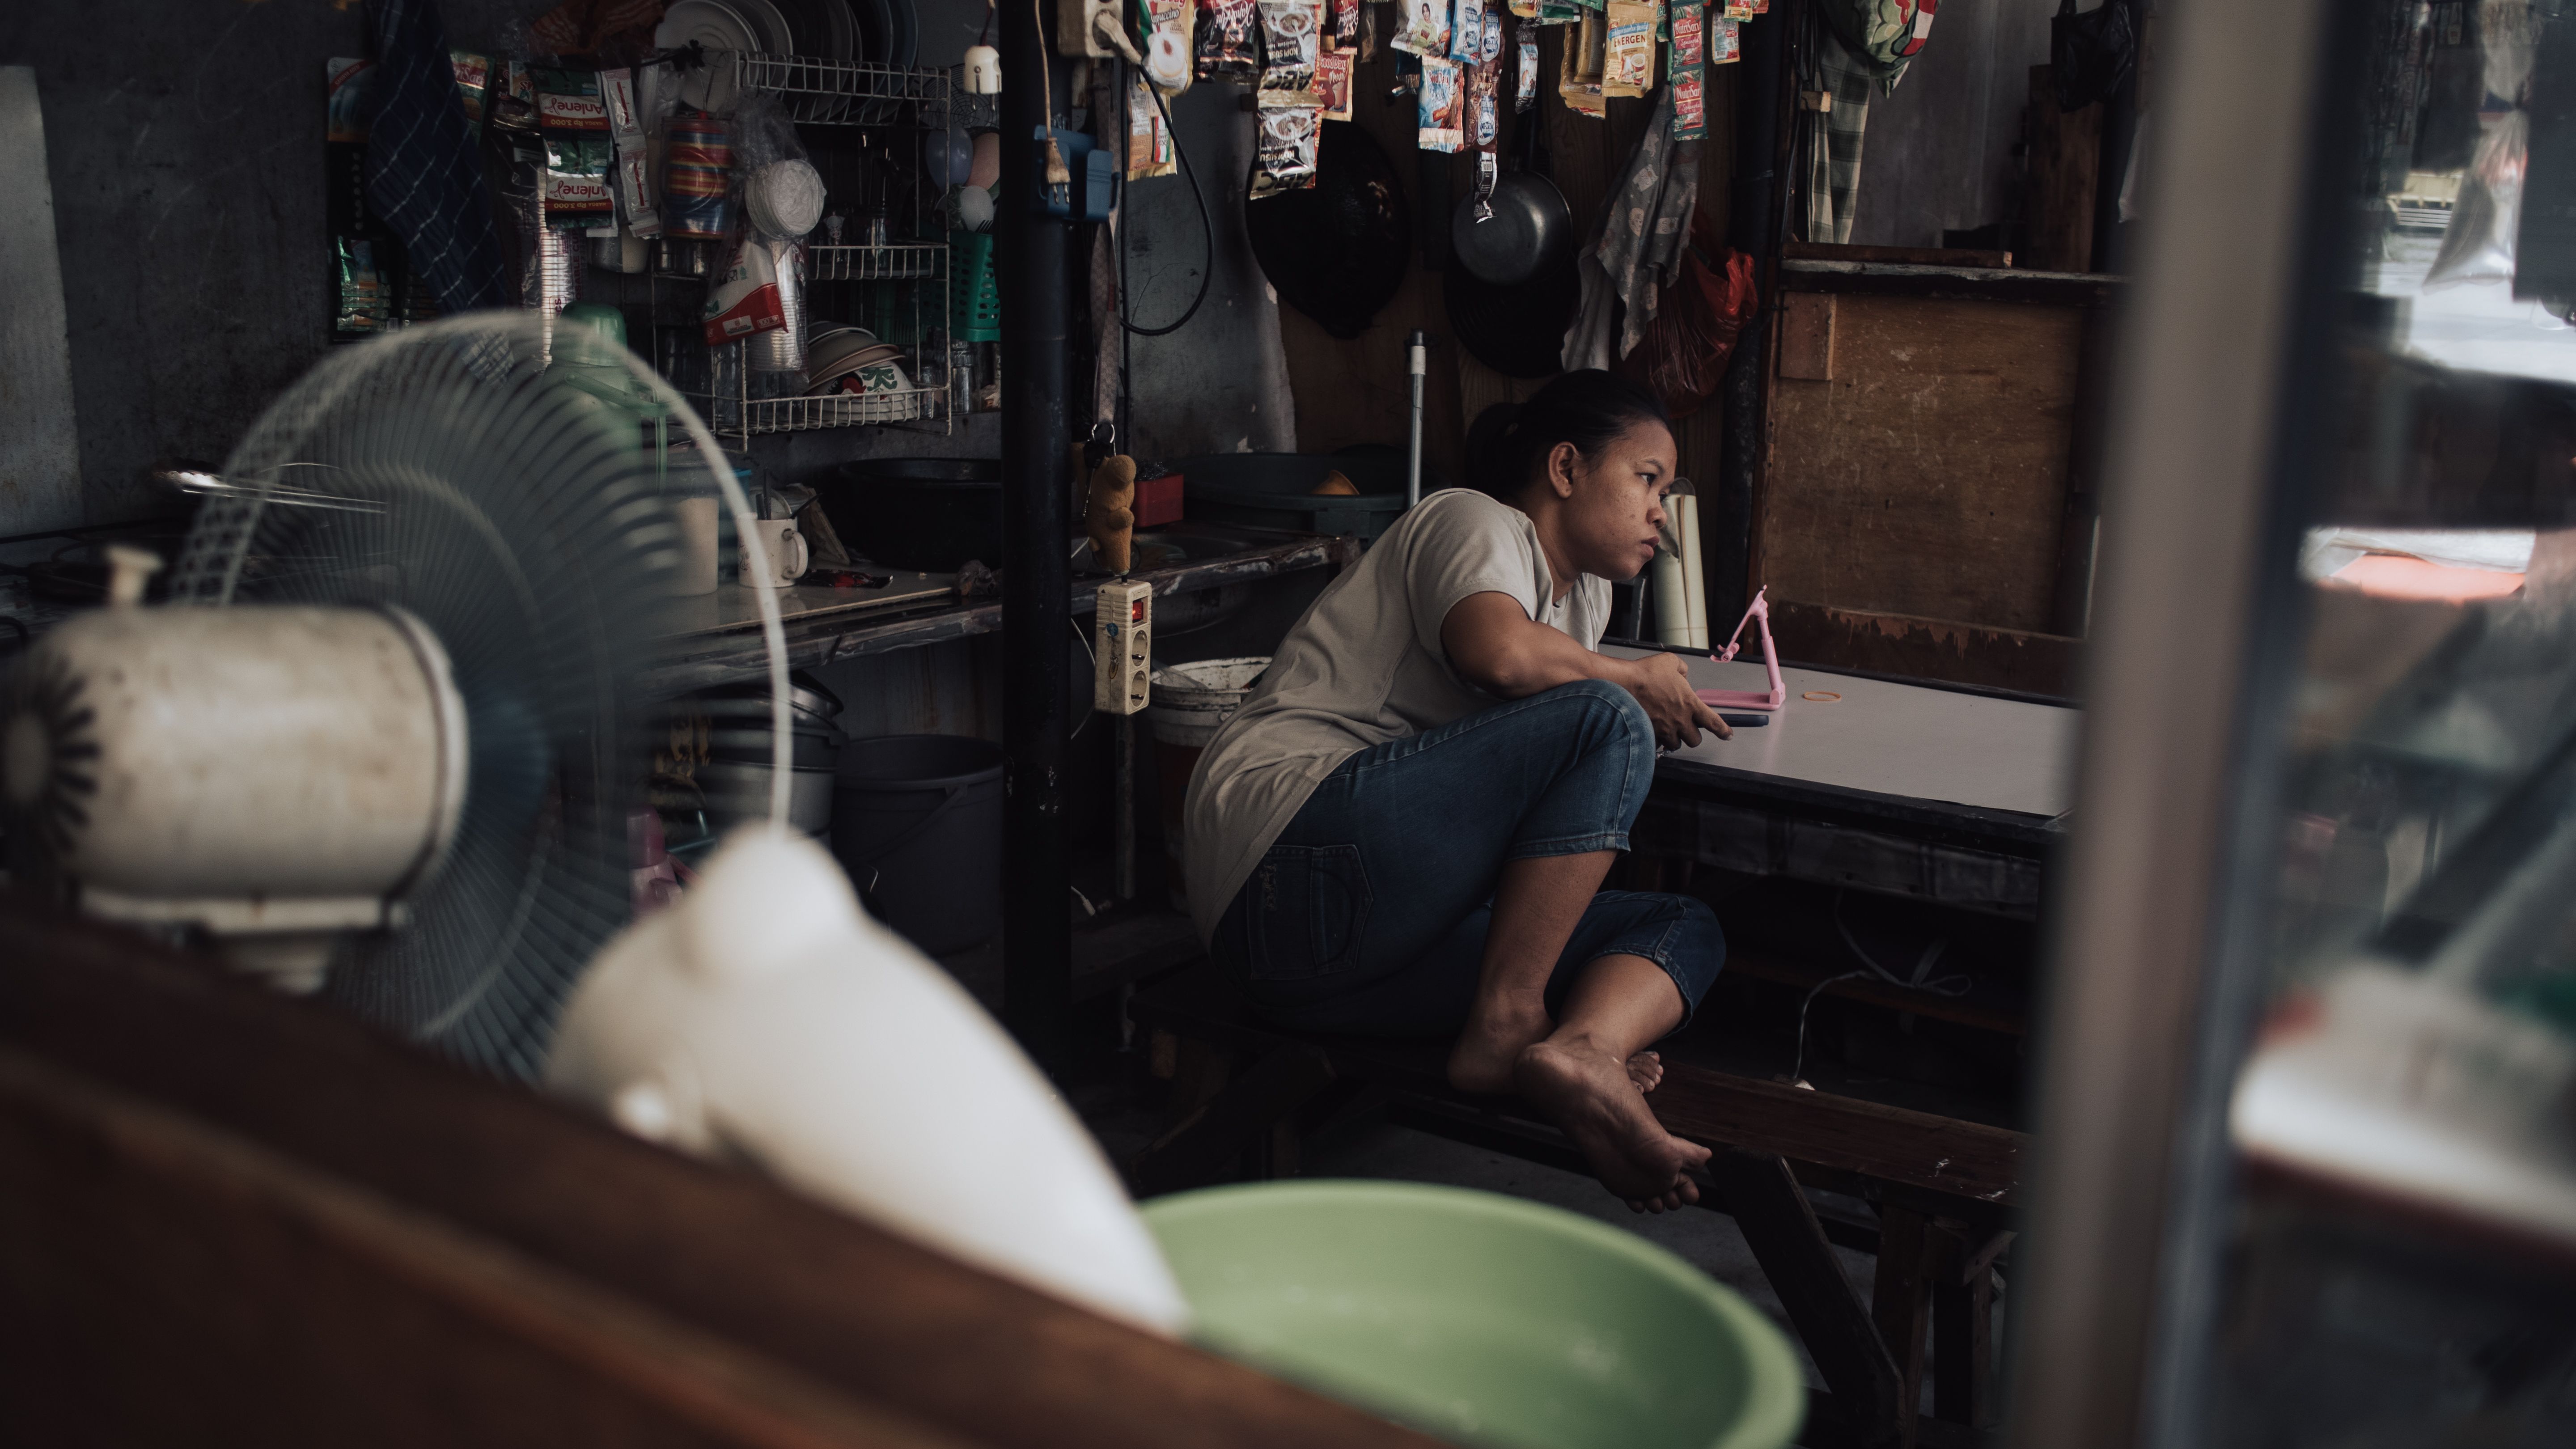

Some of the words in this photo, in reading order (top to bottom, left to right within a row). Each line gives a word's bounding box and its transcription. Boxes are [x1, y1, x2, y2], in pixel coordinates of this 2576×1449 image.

[1614, 34, 1646, 47] ENERGEN
[1284, 47, 1298, 58] KOPI
[558, 102, 602, 115] Anlene
[1259, 153, 1277, 162] SUSU
[1259, 172, 1313, 190] ABC
[563, 185, 606, 198] Anlene
[573, 255, 581, 301] OSABLE
